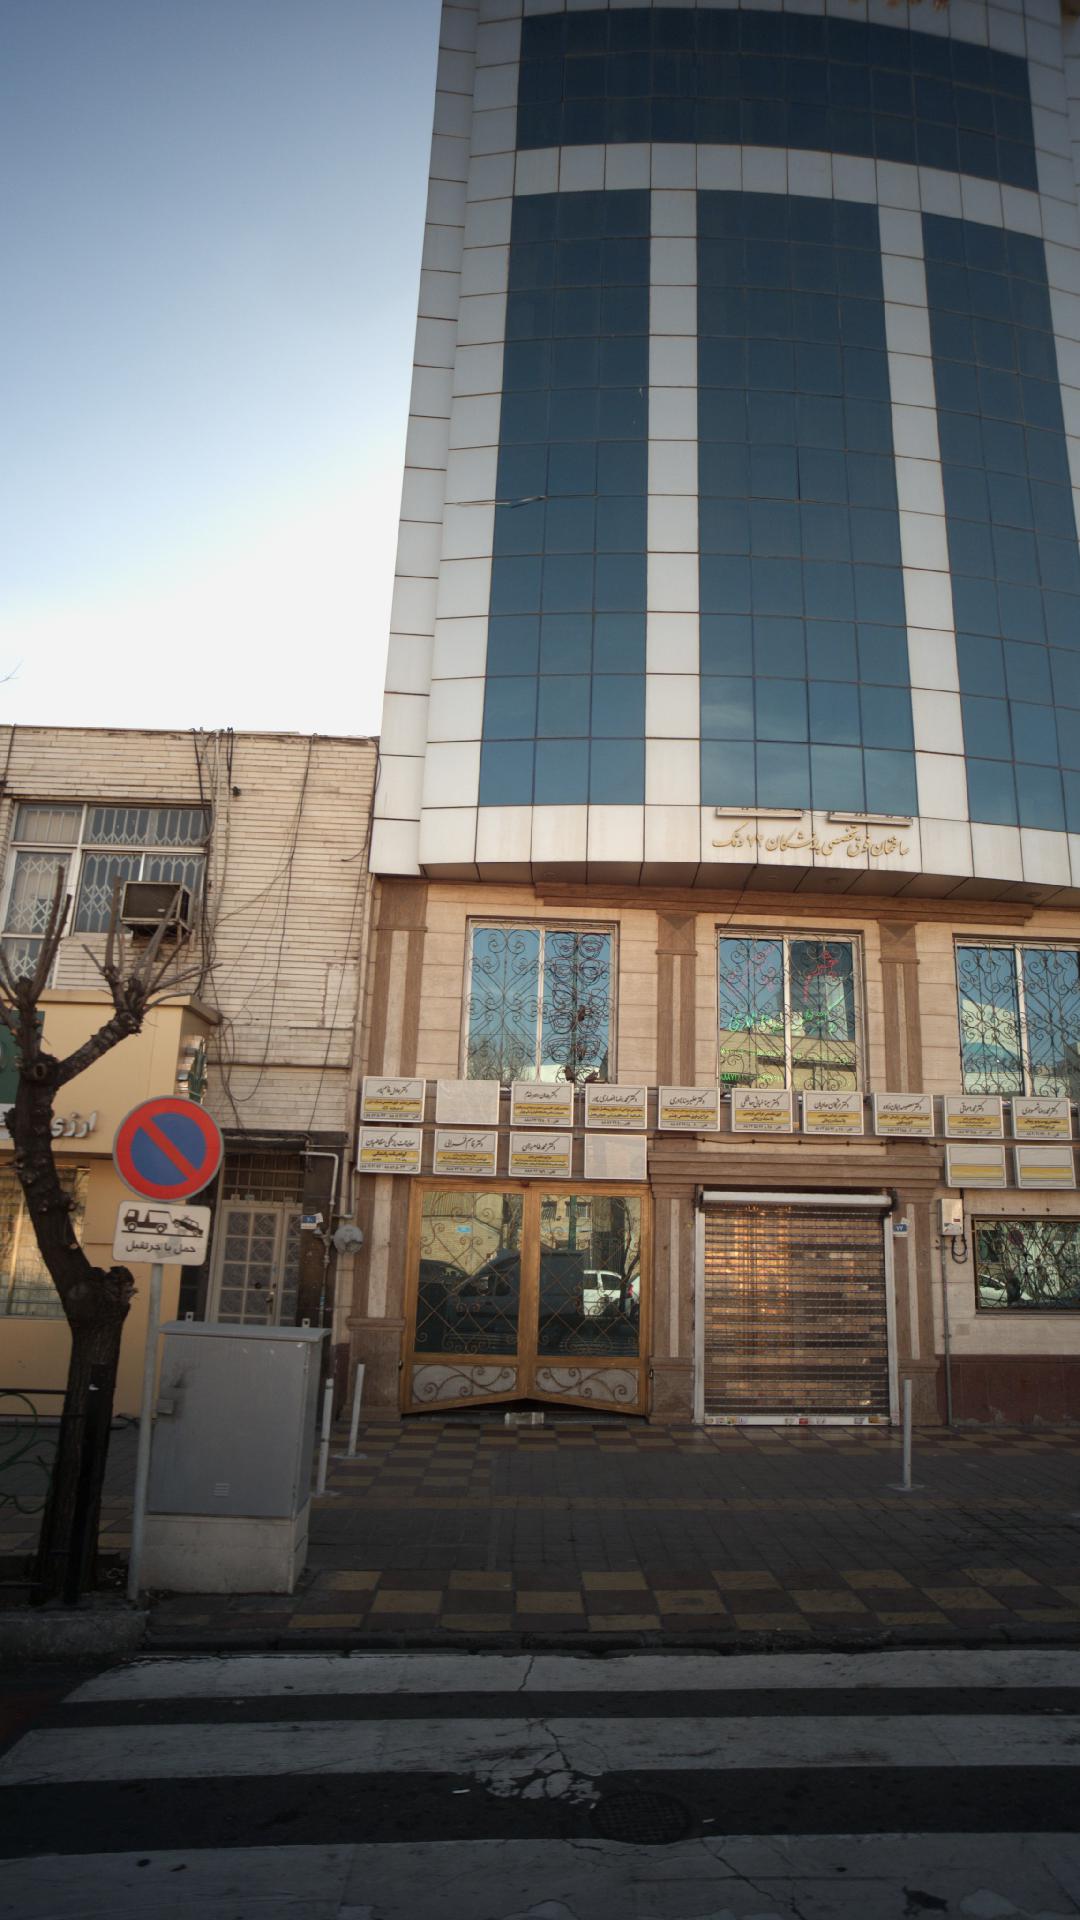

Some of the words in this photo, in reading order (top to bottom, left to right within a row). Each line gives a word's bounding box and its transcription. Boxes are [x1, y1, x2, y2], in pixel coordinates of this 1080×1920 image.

[766, 827, 821, 856] پزشکان
[822, 824, 860, 856] تخصصی
[847, 833, 873, 857] فوق
[871, 835, 909, 857] ساختمان
[164, 1242, 172, 1252] با
[174, 1244, 196, 1255] حمل
